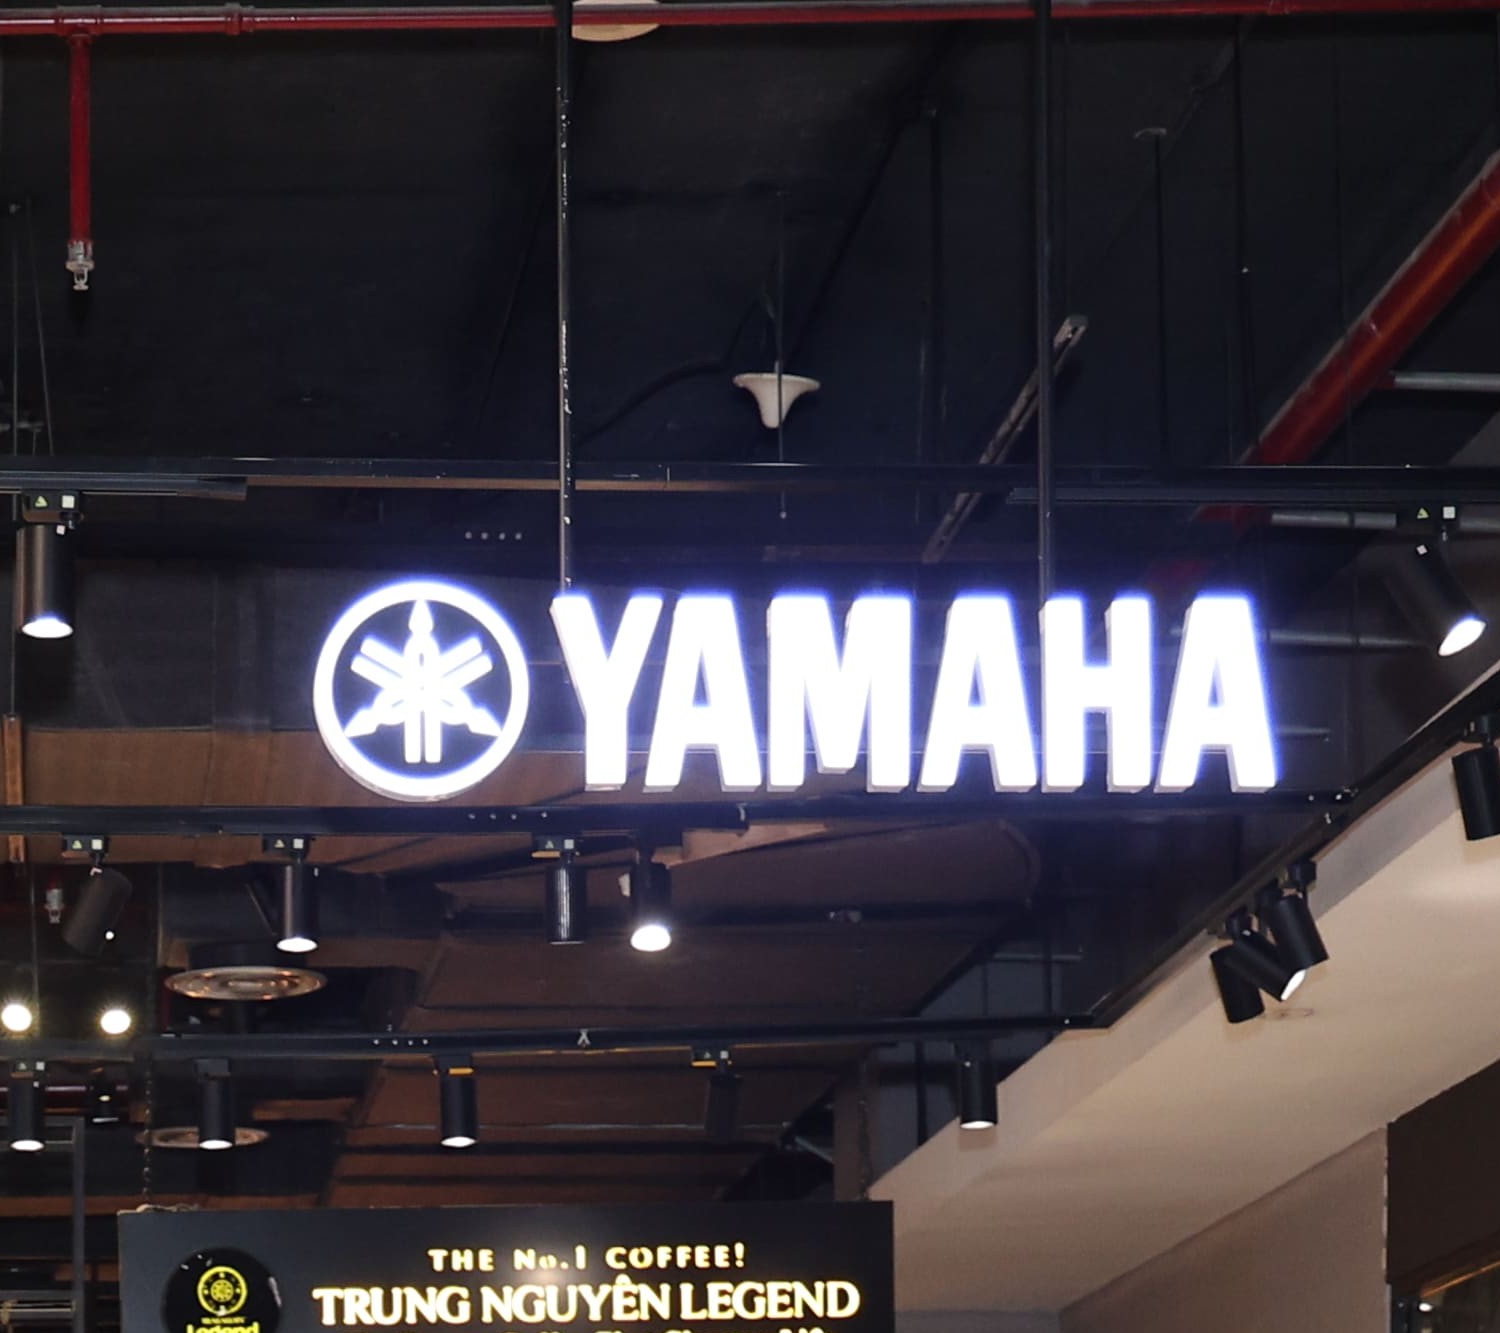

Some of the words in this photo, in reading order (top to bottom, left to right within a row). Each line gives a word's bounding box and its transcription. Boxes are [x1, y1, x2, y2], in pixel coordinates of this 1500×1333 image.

[550, 594, 1278, 793] YAMAHA
[427, 1248, 494, 1272] THE
[605, 1242, 746, 1270] COFFEE!
[313, 1286, 470, 1326] TRUNG
[481, 1274, 671, 1324] NGUYÊN
[680, 1281, 861, 1320] LEGEND
